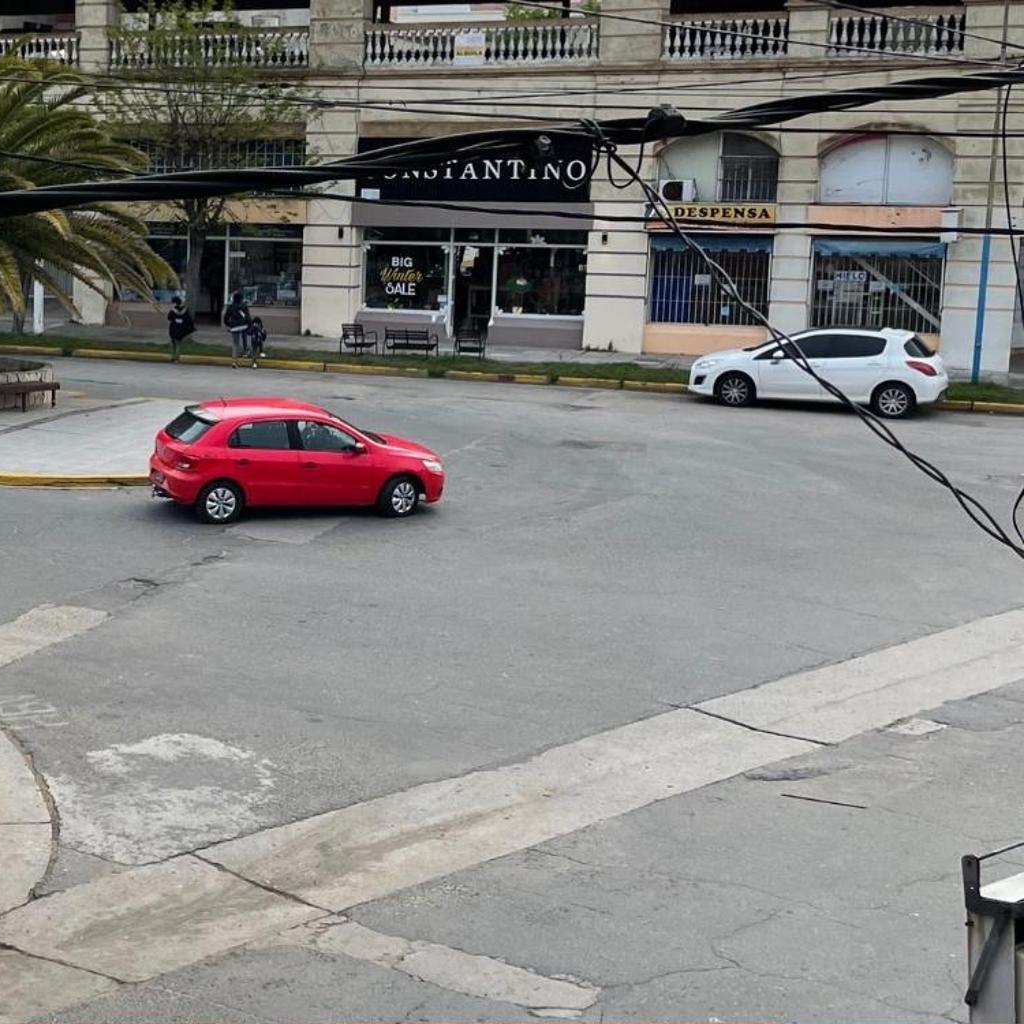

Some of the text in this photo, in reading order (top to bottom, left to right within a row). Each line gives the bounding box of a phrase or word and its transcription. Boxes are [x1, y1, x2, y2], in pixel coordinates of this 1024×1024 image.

[673, 206, 772, 219] DESPENSA
[391, 256, 413, 268] BIG
[379, 267, 424, 283] Winter
[384, 282, 417, 296] SALE
